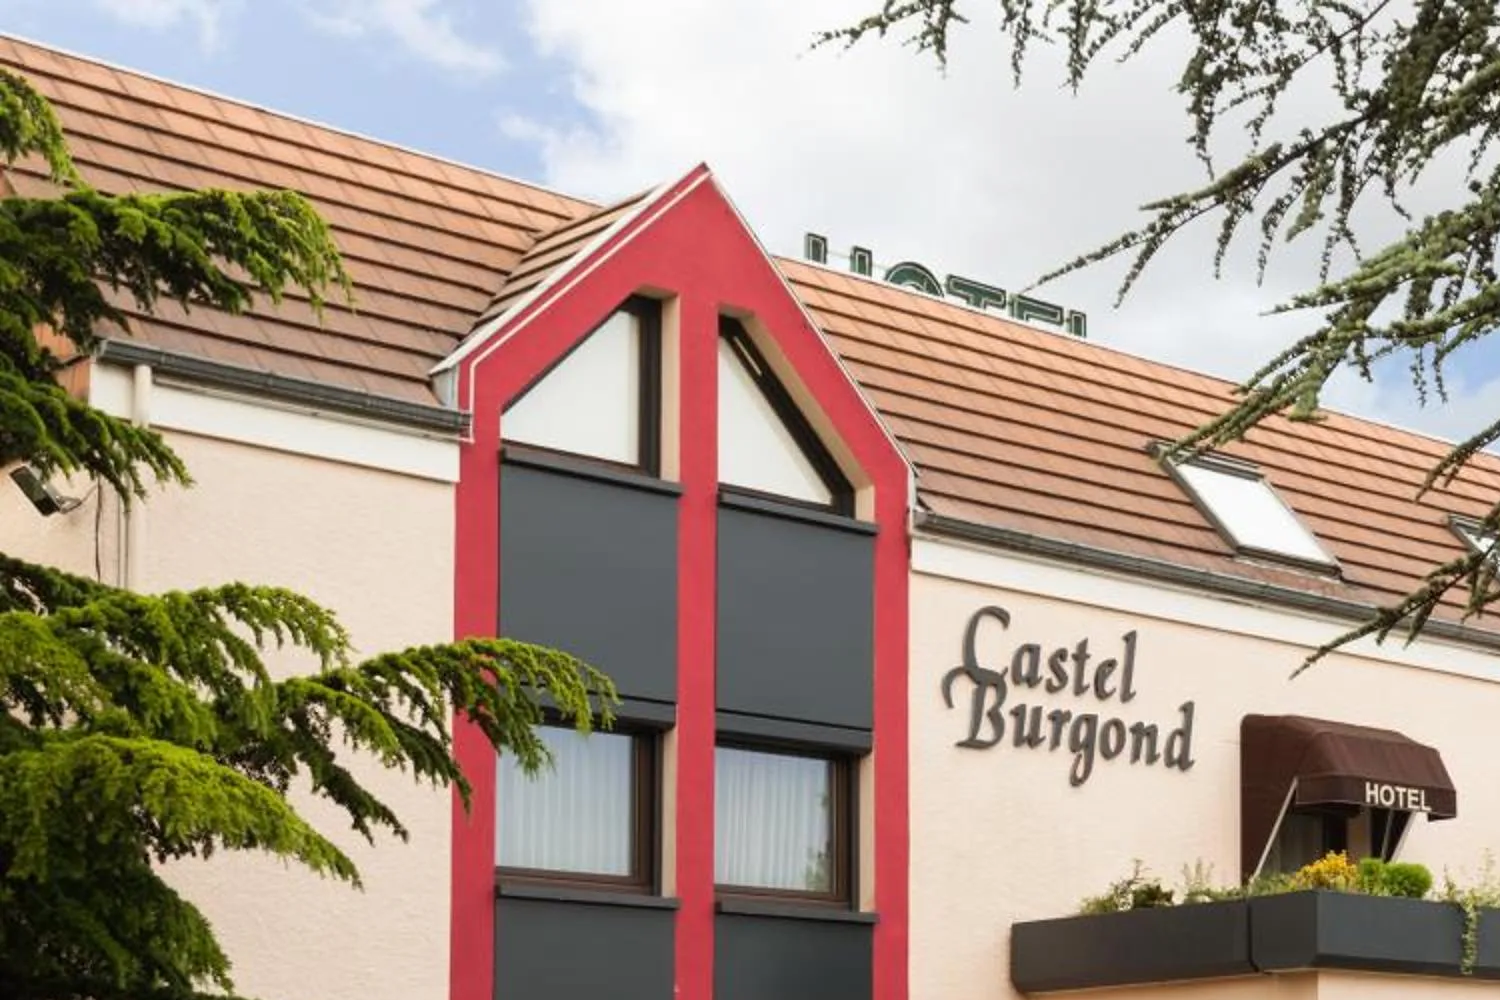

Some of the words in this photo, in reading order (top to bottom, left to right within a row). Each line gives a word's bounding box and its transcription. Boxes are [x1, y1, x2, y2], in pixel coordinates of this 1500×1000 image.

[961, 605, 1137, 703] Castel
[941, 665, 1195, 787] Burgond
[1364, 781, 1431, 811] HOTEL
